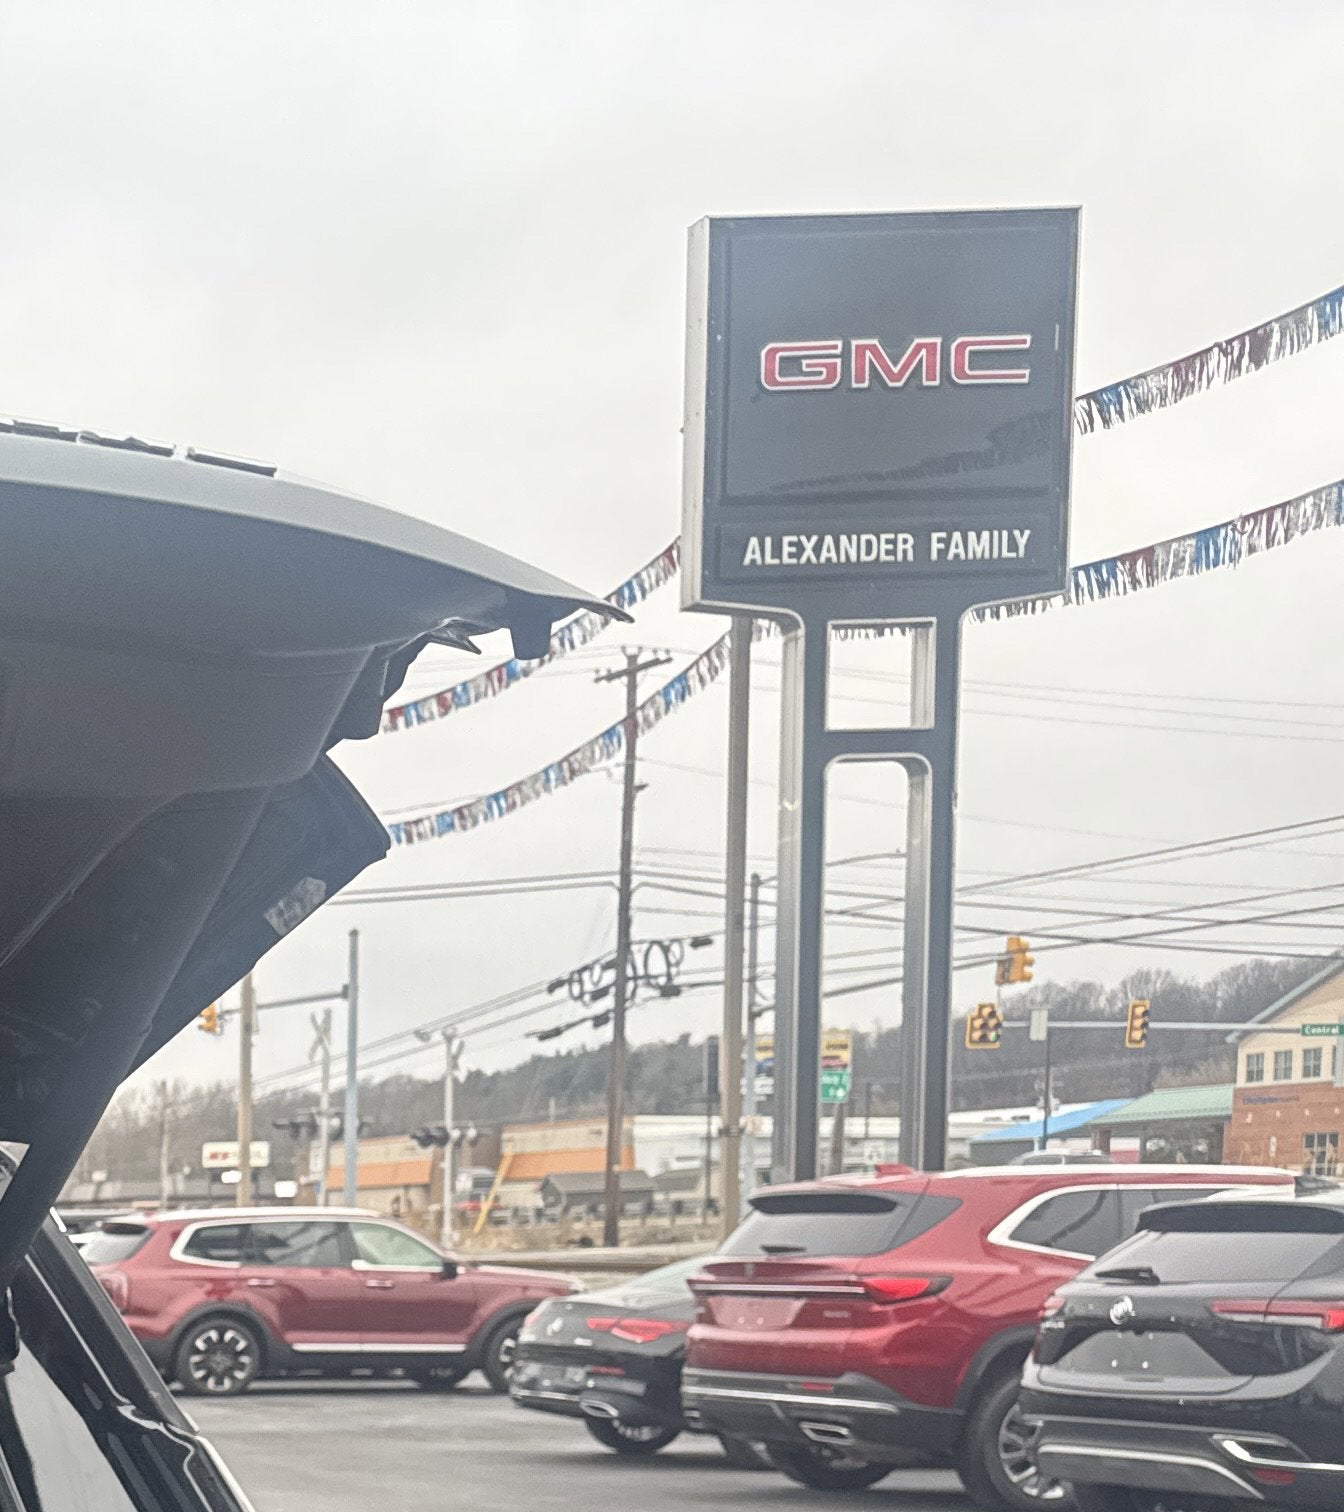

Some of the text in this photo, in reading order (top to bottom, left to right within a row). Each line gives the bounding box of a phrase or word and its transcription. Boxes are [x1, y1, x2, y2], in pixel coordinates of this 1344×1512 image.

[760, 334, 1032, 391] GMC
[743, 529, 1032, 567] ALEXANDER FAMILY
